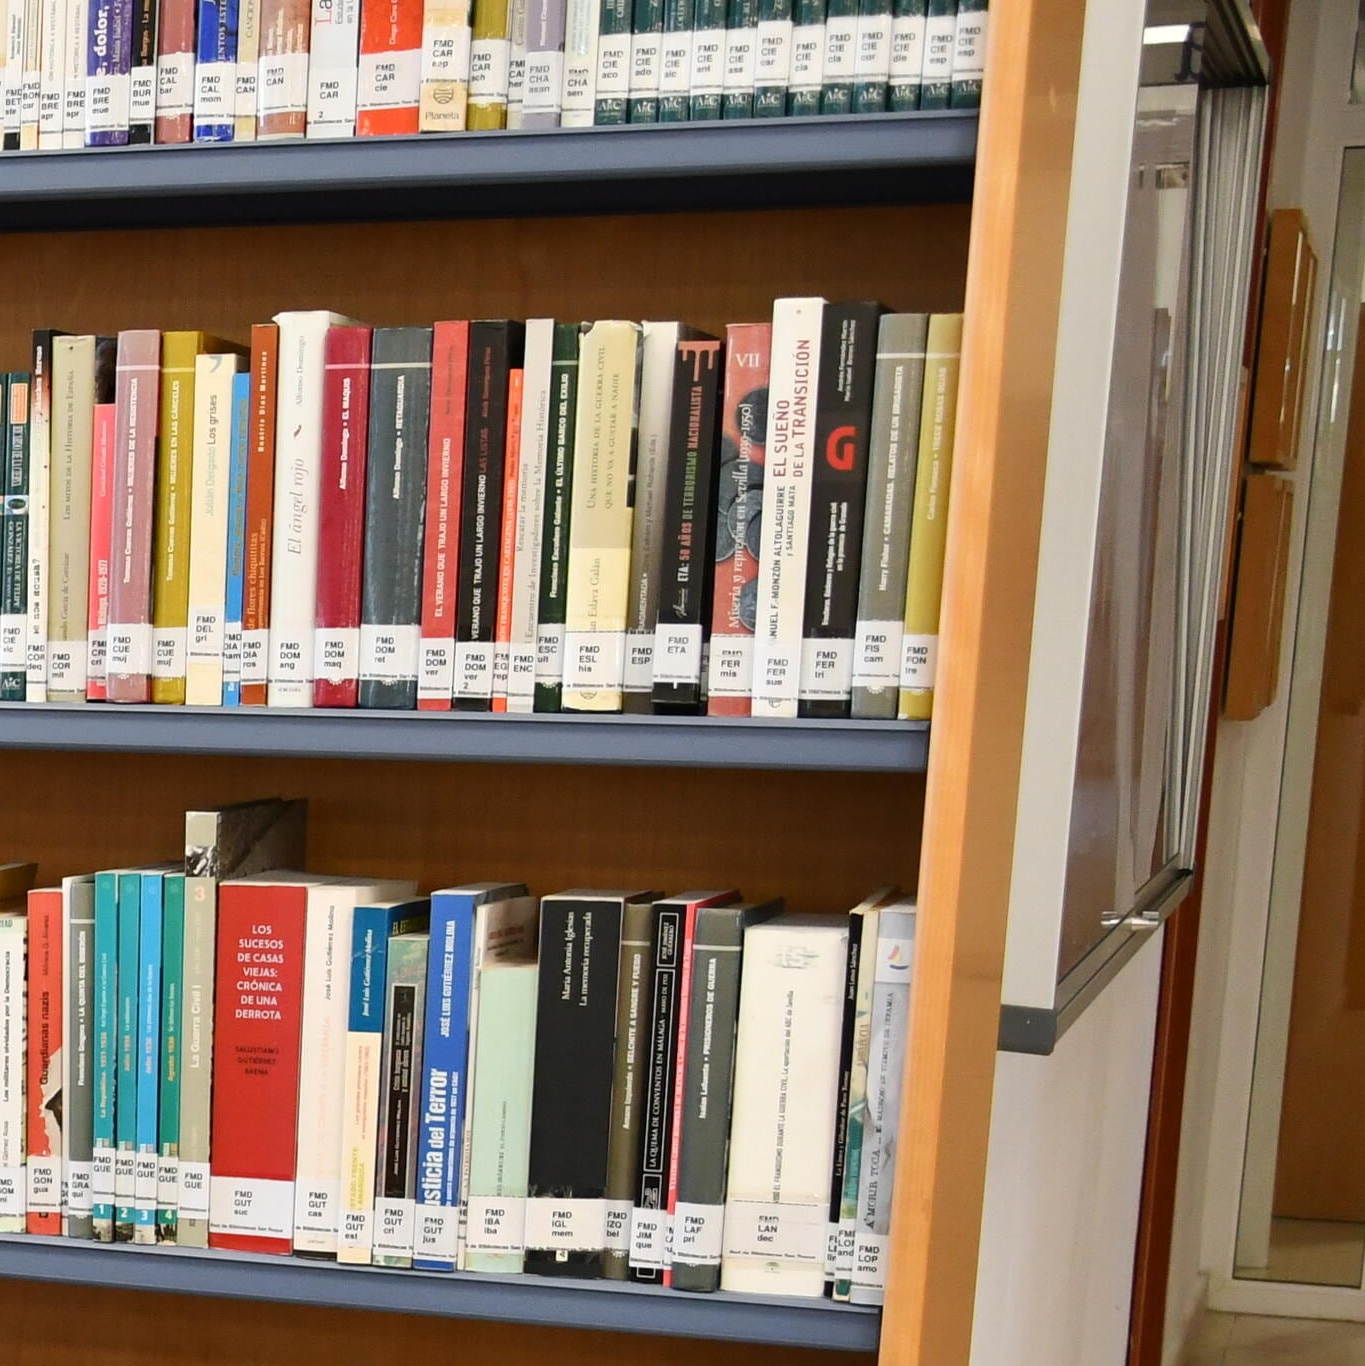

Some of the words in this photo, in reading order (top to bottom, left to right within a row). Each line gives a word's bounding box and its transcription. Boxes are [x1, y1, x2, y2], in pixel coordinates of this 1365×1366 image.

[735, 353, 759, 368] VII
[791, 340, 809, 438] TRANSICIÓN
[206, 394, 219, 425] grises
[686, 386, 702, 448] NACIONALISTA
[772, 400, 789, 453] SUEÑO
[206, 427, 216, 445] Los
[794, 442, 805, 458] LA
[290, 458, 309, 486] rojo
[773, 458, 787, 477] EL
[793, 462, 803, 477] DE
[682, 452, 697, 506] TERRORISMO
[289, 491, 308, 534] ángel
[682, 510, 693, 519] DE
[678, 522, 693, 546] AÑOS
[287, 538, 302, 555] El
[680, 550, 690, 560] 50
[251, 924, 273, 936] LOS
[565, 912, 576, 940] Iglesias
[582, 912, 593, 956] recuperada
[238, 938, 284, 950] SUCESOS
[237, 953, 251, 963] DE
[253, 952, 284, 964] CASAS
[562, 943, 573, 975] Antonia
[242, 966, 278, 977] VIEJAS:
[580, 958, 590, 994] memoria
[236, 977, 283, 992] CRÓNICA
[240, 995, 253, 1005] DE
[255, 995, 277, 1006] UNA
[579, 996, 588, 1006] La
[235, 1008, 281, 1020] DERROTA
[426, 1068, 447, 1123] Terror
[428, 1127, 444, 1148] del
[234, 1190, 253, 1199] FMD
[234, 1199, 252, 1208] GUT
